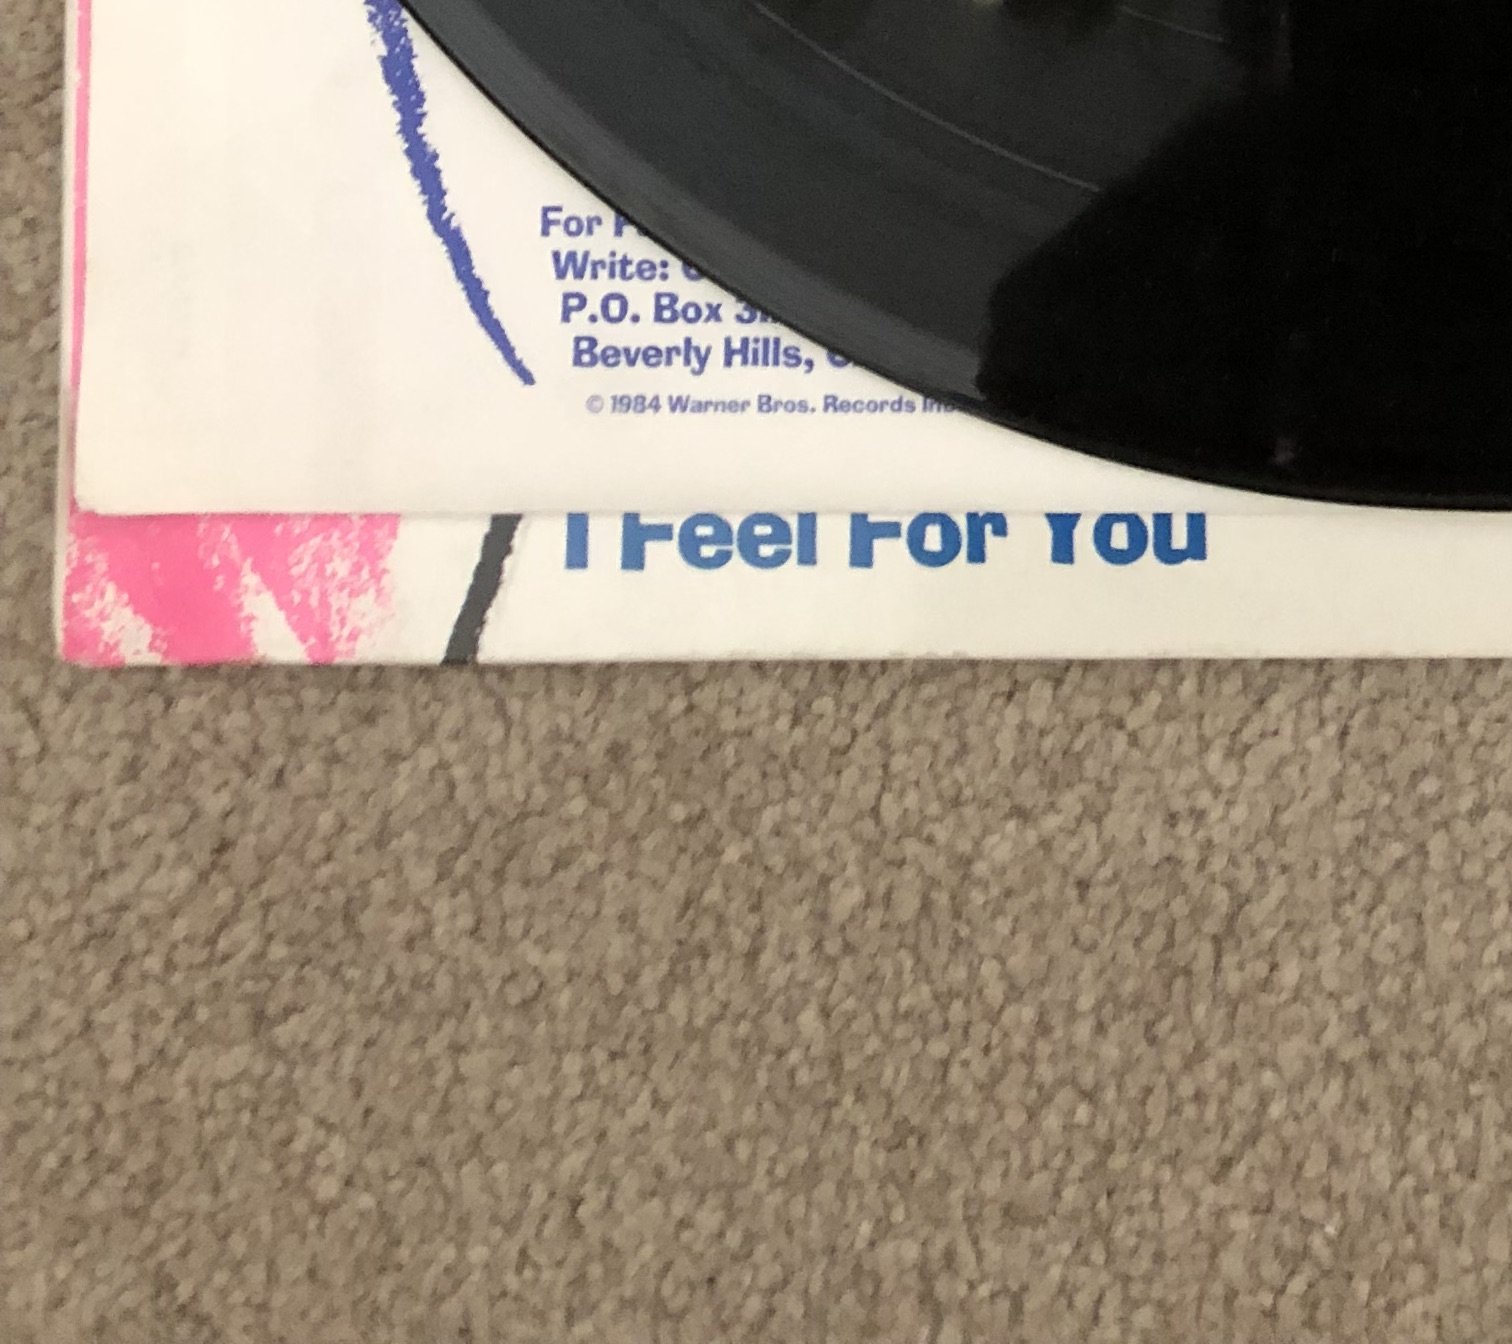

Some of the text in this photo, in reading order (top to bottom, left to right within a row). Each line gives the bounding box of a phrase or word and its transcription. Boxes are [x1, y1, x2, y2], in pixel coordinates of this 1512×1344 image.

[540, 205, 602, 237] For
[552, 250, 669, 281] Write:
[561, 292, 640, 323] P.O.
[653, 292, 722, 324] Box
[572, 335, 712, 376] Beverly
[723, 336, 815, 373] Hills,
[610, 394, 661, 415] 1984
[669, 395, 751, 415] Warner
[757, 394, 816, 414] Bros.
[823, 394, 916, 414] Records
[563, 512, 1208, 571] I Feel For You
